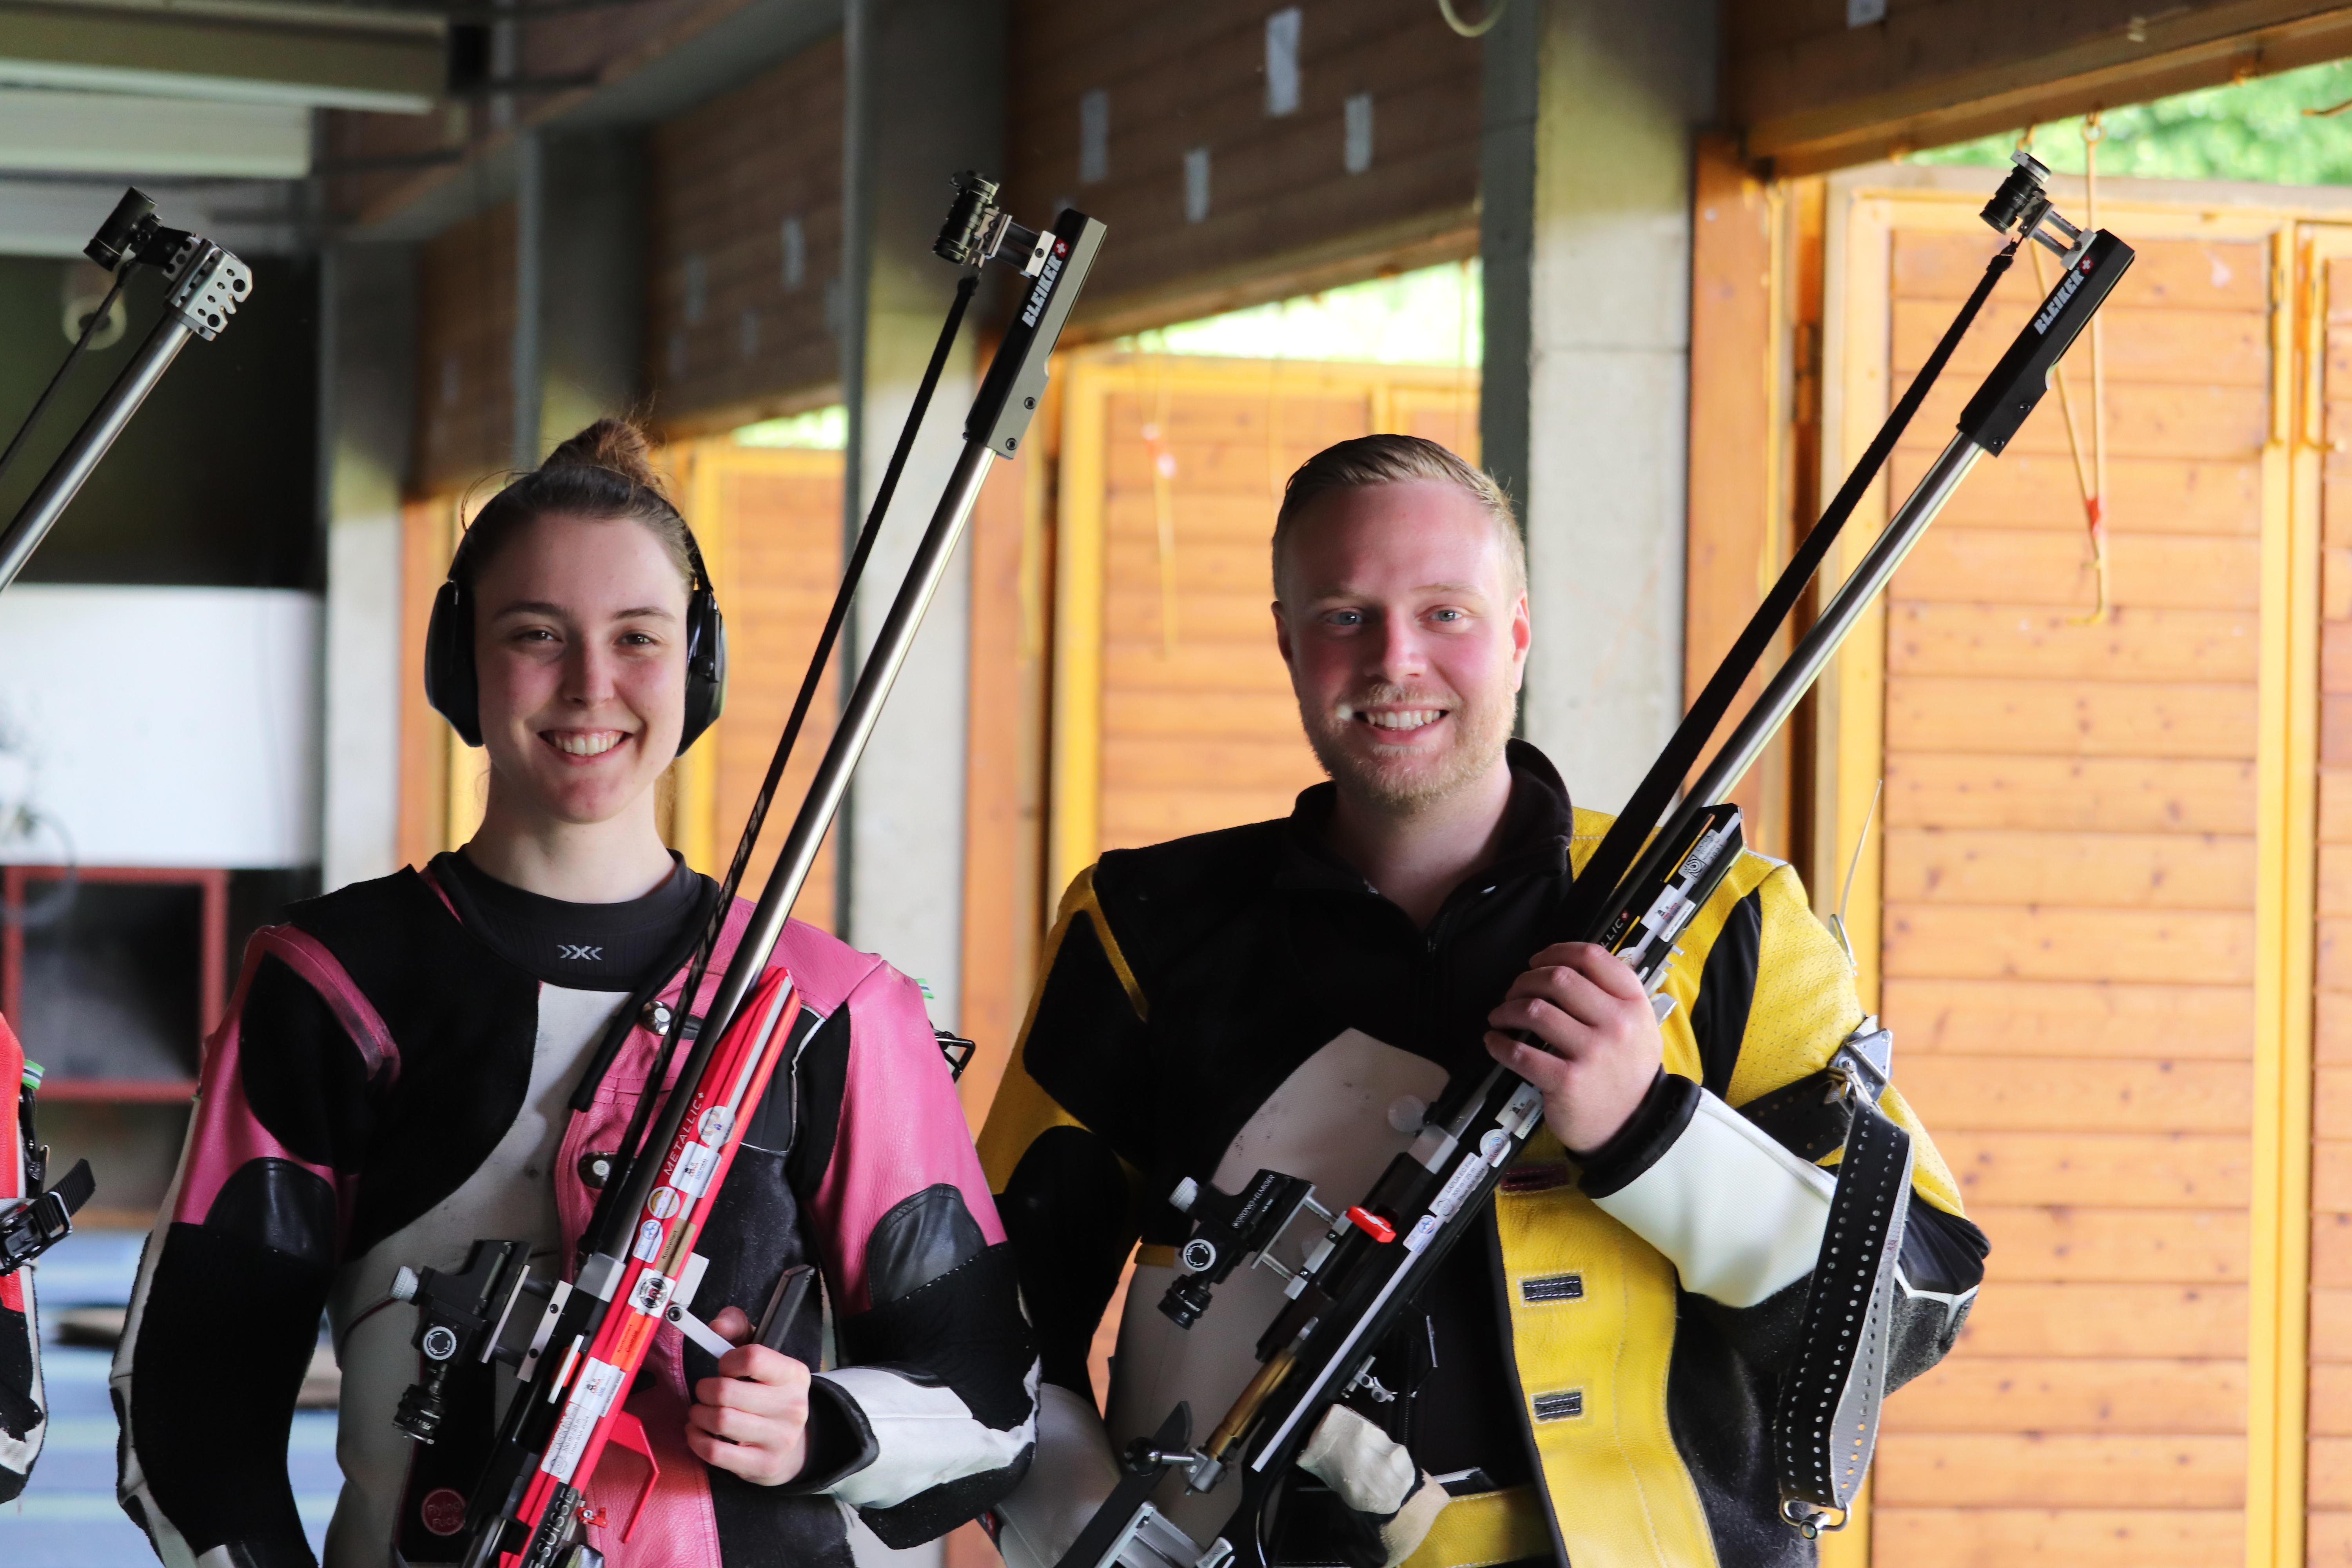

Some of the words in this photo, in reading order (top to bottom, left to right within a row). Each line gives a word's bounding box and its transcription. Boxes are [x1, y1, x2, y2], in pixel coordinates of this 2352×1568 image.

[1022, 255, 1062, 328] BLEIKER
[2033, 269, 2085, 335] BLEIKER
[1601, 918, 1623, 948] LLIC
[664, 1100, 702, 1176] METALLIC
[1446, 1176, 1461, 1194] LAPUA
[1458, 1167, 1467, 1176] EC
[1464, 1155, 1475, 1168] Final
[1451, 1187, 1461, 1198] 300
[661, 1229, 678, 1259] Kontrolliert
[537, 1488, 575, 1558] SUISSE
